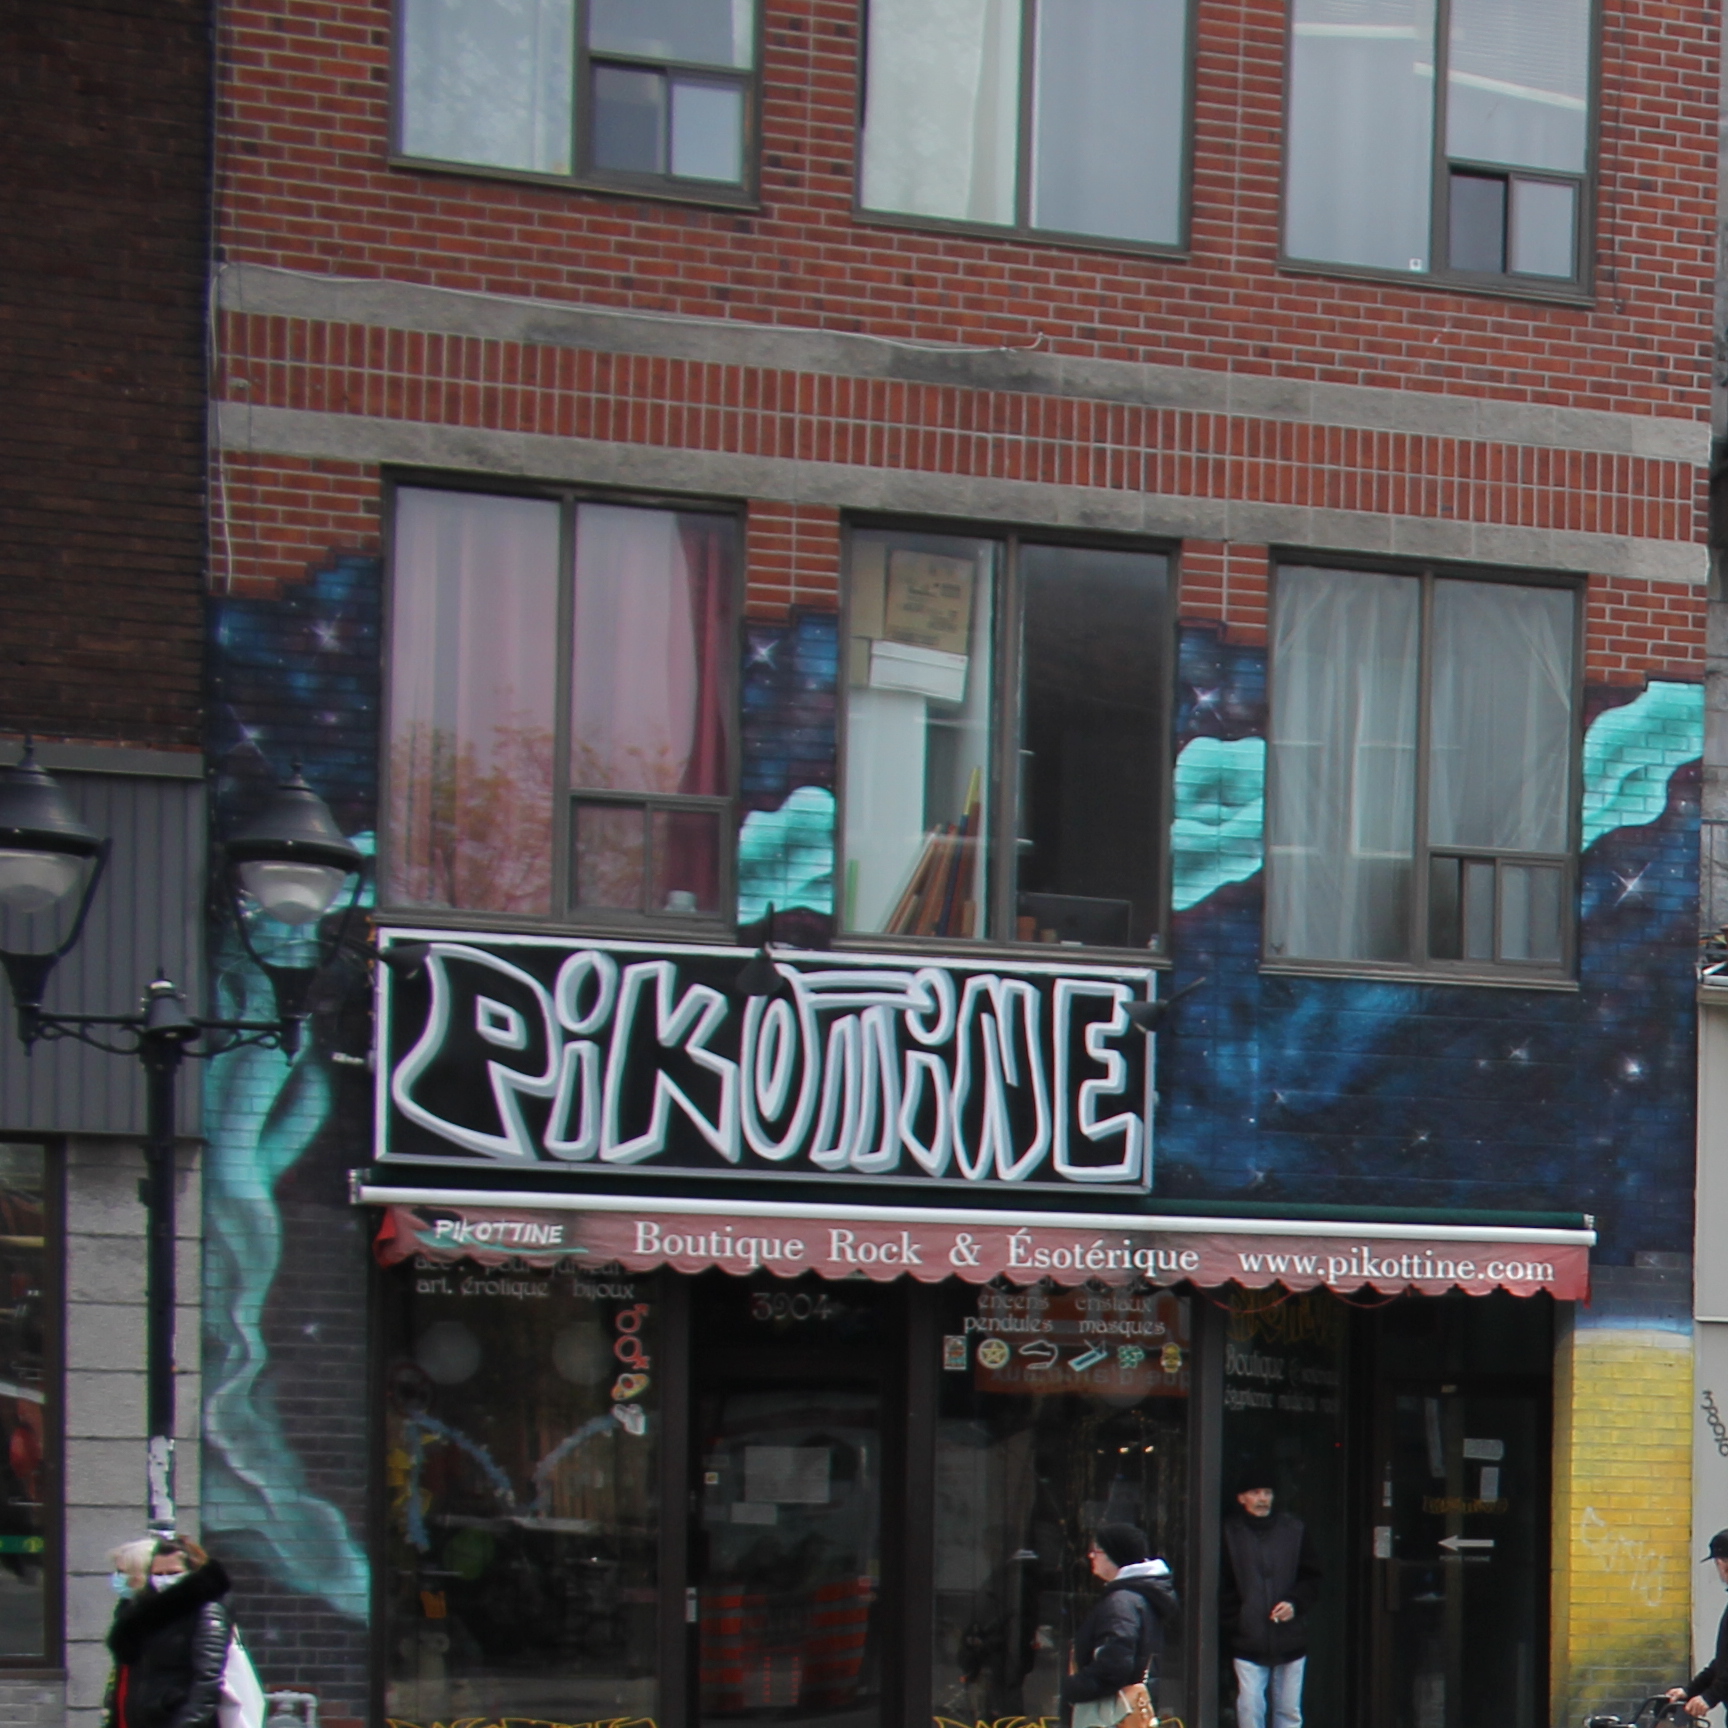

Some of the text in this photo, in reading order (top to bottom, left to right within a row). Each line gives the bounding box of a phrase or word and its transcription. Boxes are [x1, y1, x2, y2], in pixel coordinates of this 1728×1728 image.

[633, 1221, 805, 1266] Boutique
[827, 1228, 922, 1265] Rock
[948, 1233, 980, 1265] &
[1005, 1228, 1199, 1277] Ésotérique
[1239, 1246, 1555, 1284] www.pikottine.com
[963, 1313, 1166, 1338] pendules masques
